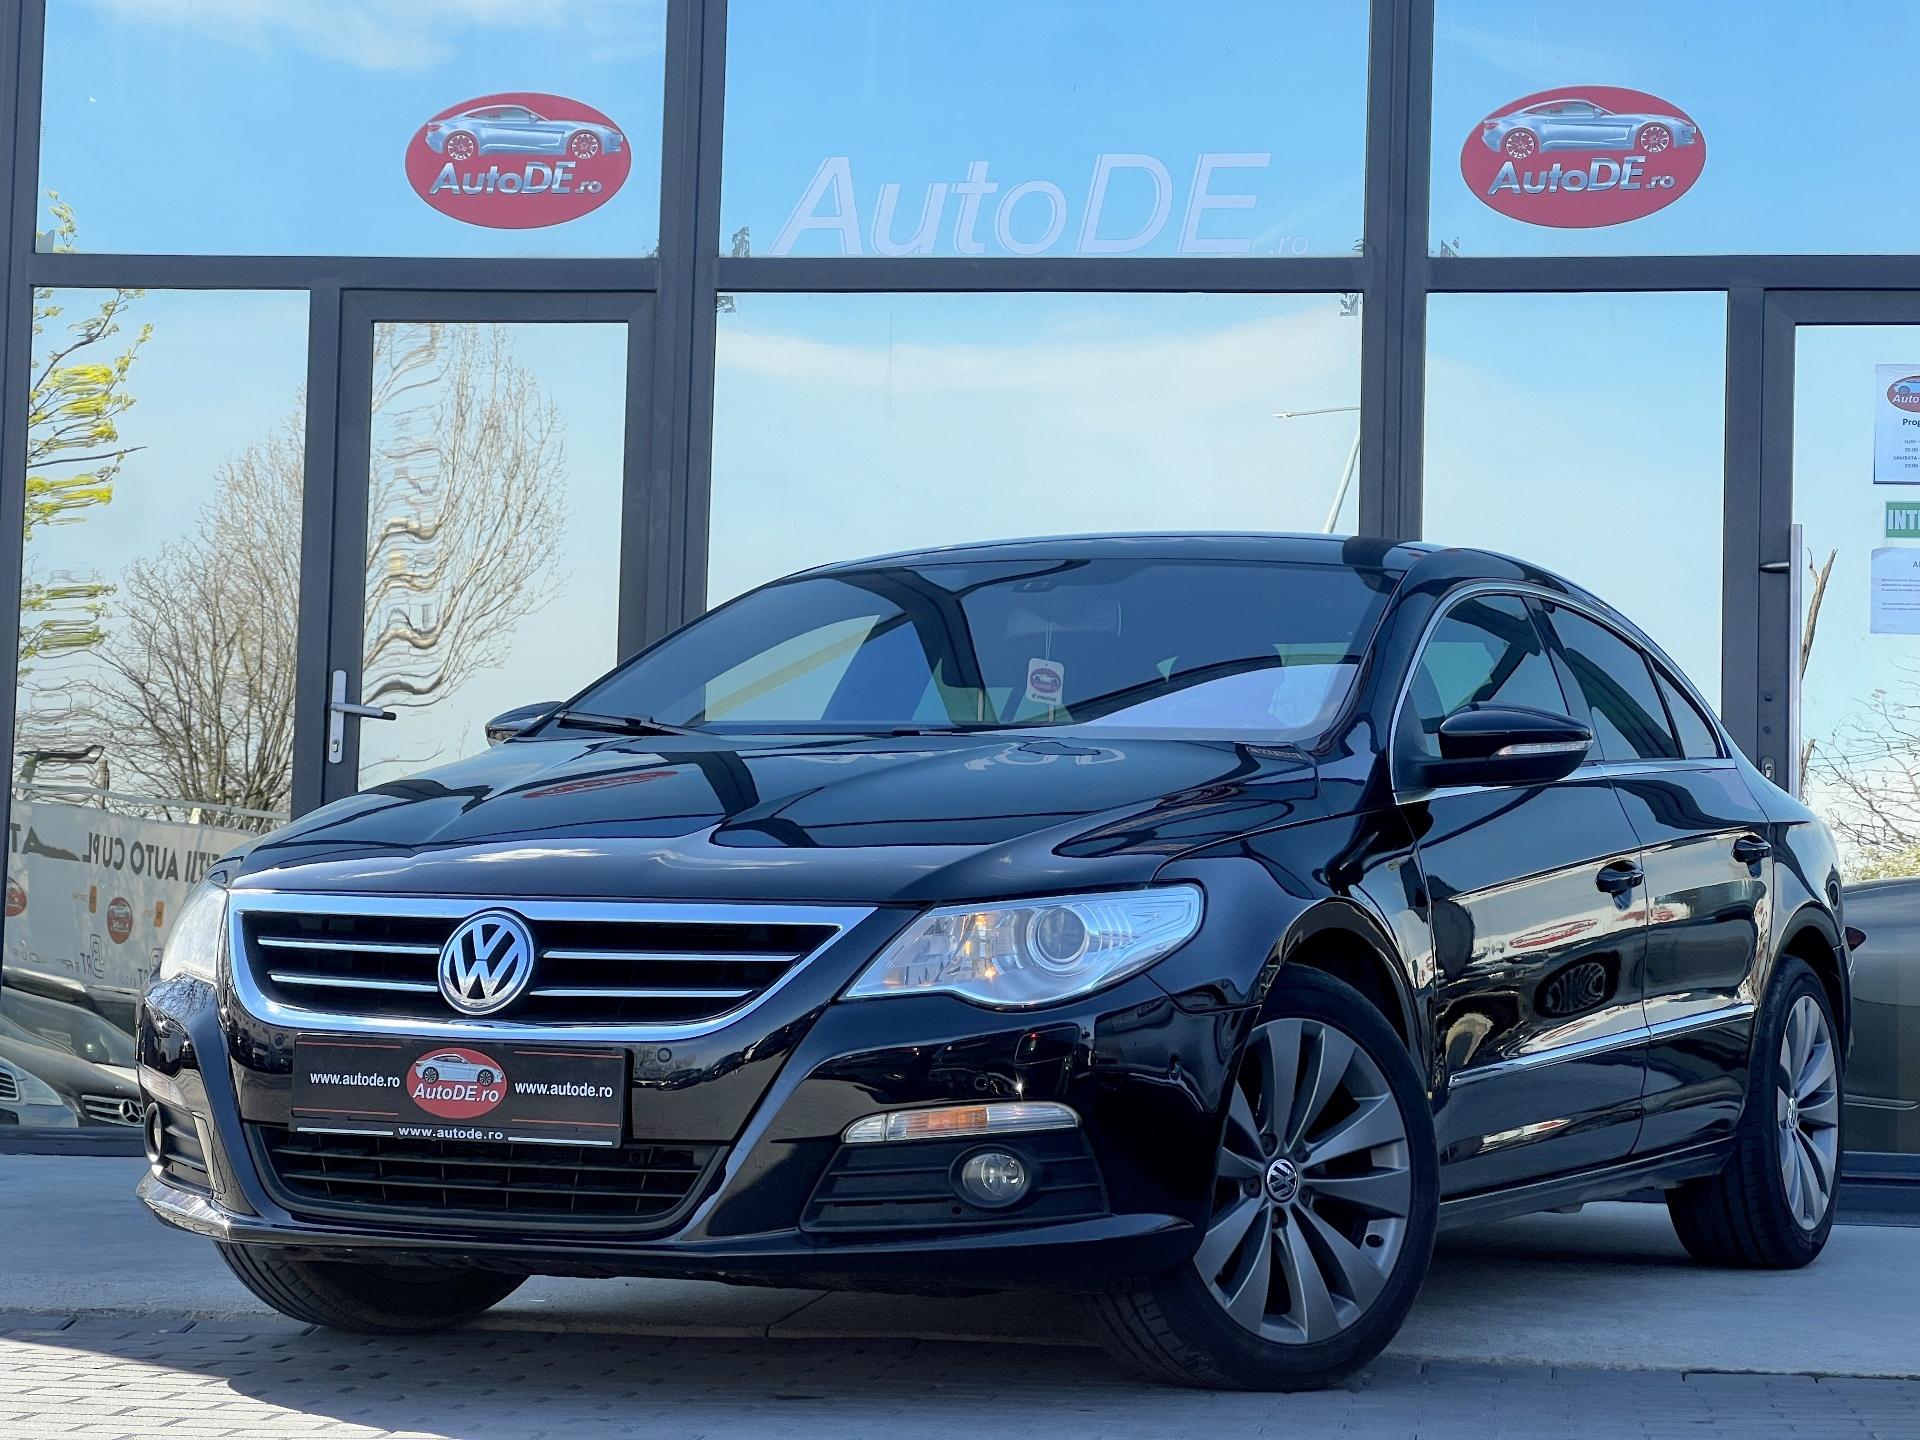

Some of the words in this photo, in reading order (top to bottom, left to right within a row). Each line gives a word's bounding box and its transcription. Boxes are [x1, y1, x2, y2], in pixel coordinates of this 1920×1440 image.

[1888, 509, 1920, 530] INT
[441, 914, 531, 1011] VW
[309, 1071, 401, 1088] www.autode.ro
[412, 1081, 500, 1104] AutoDE.ro
[514, 1080, 613, 1099] www.autode.ro
[397, 1126, 504, 1141] www.autode.ro
